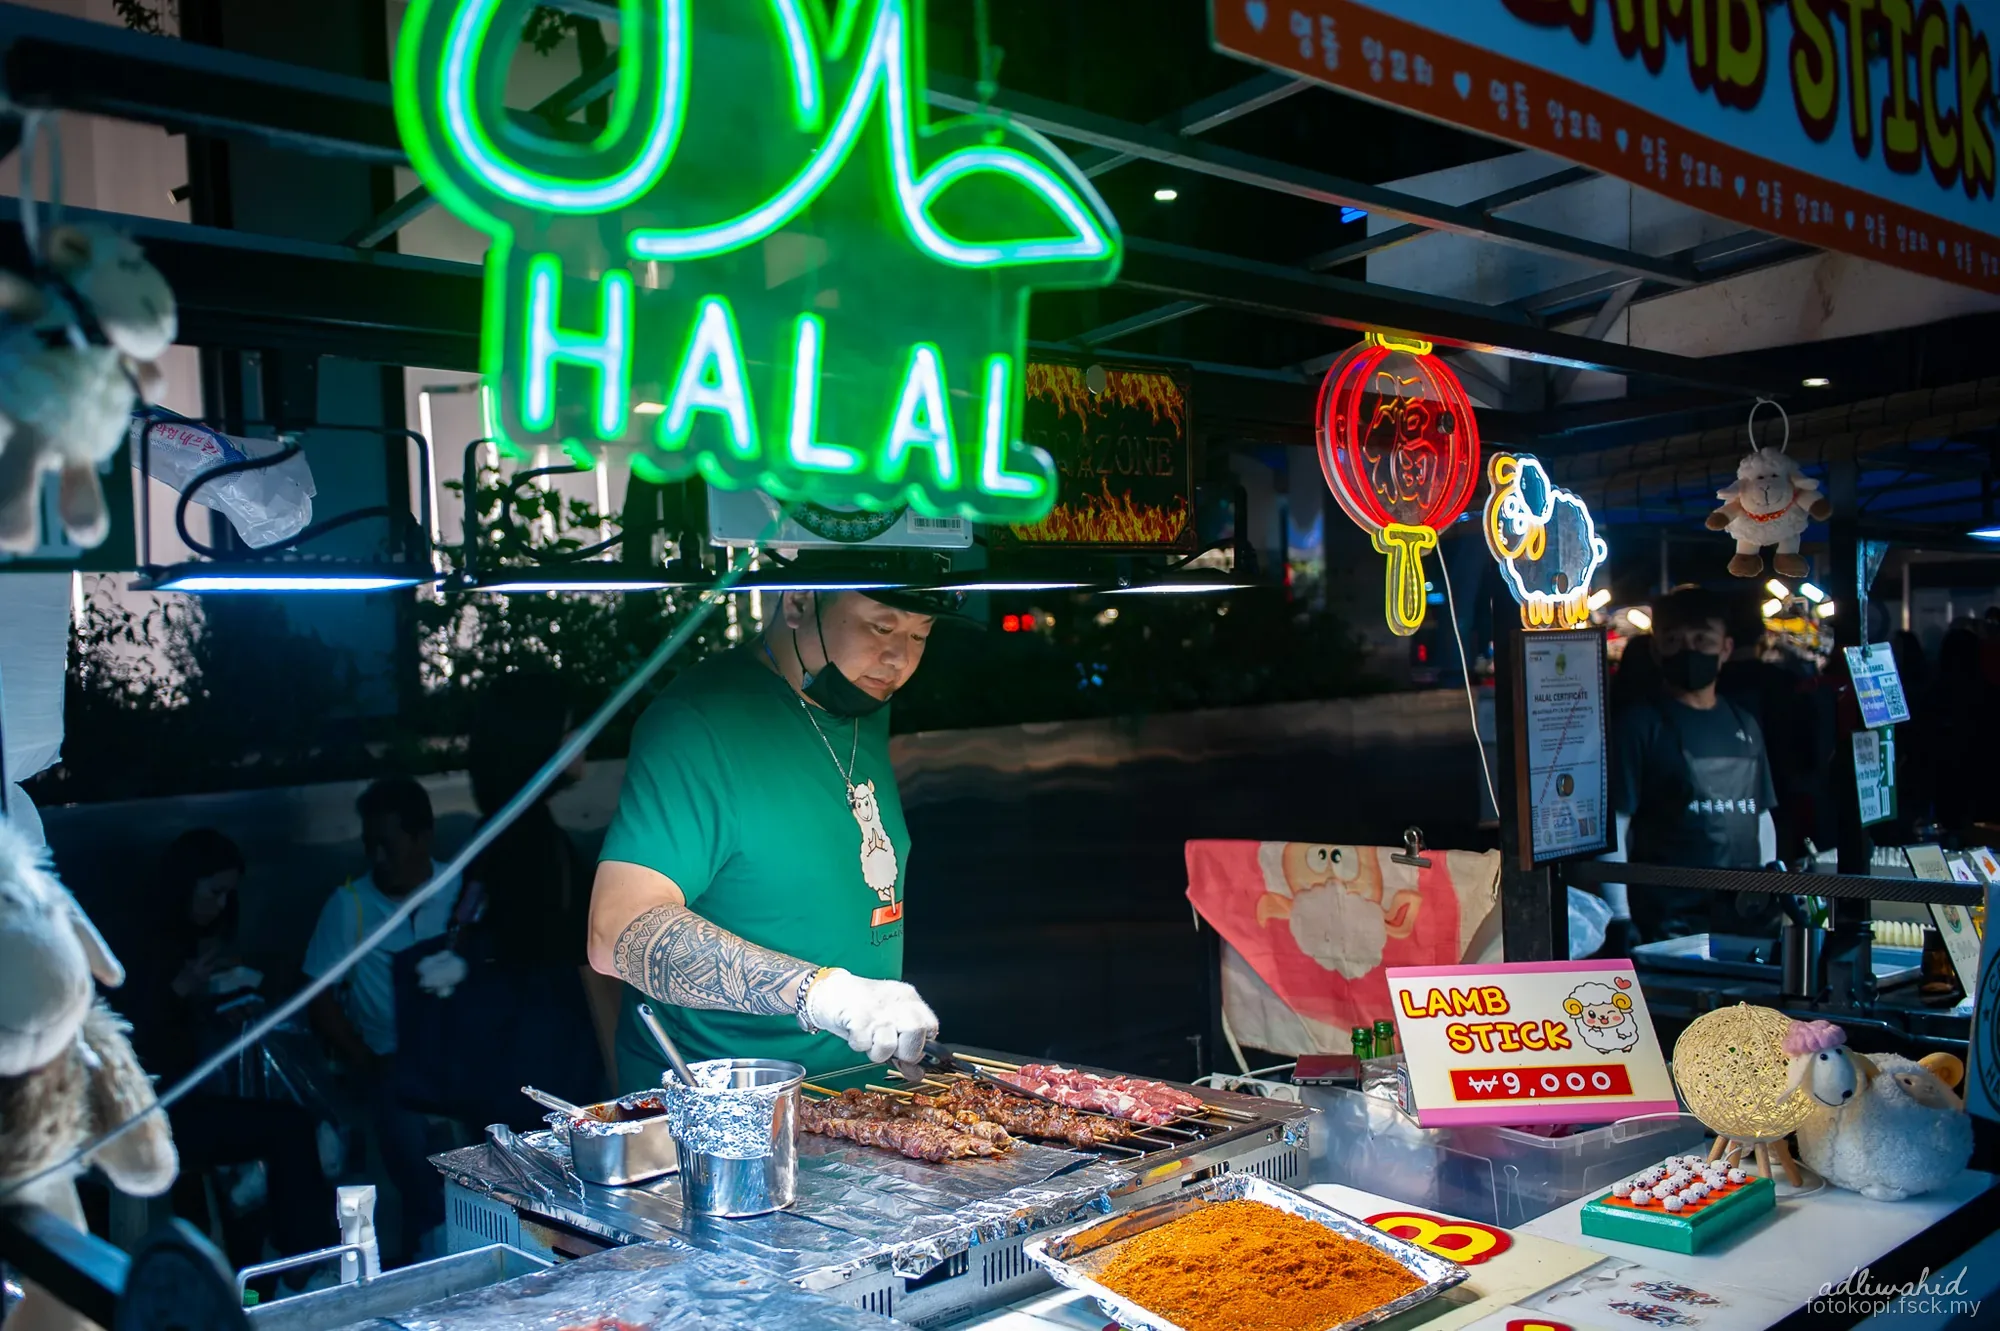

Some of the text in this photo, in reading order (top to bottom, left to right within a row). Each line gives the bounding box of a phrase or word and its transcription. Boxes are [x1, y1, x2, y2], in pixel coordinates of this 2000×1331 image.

[1788, 0, 1996, 201] STICK
[519, 252, 1050, 501] HALAL
[1534, 691, 1588, 702] HALAL CERTIFICATE
[1400, 986, 1511, 1019] LAMB
[1446, 1019, 1573, 1054] STICK
